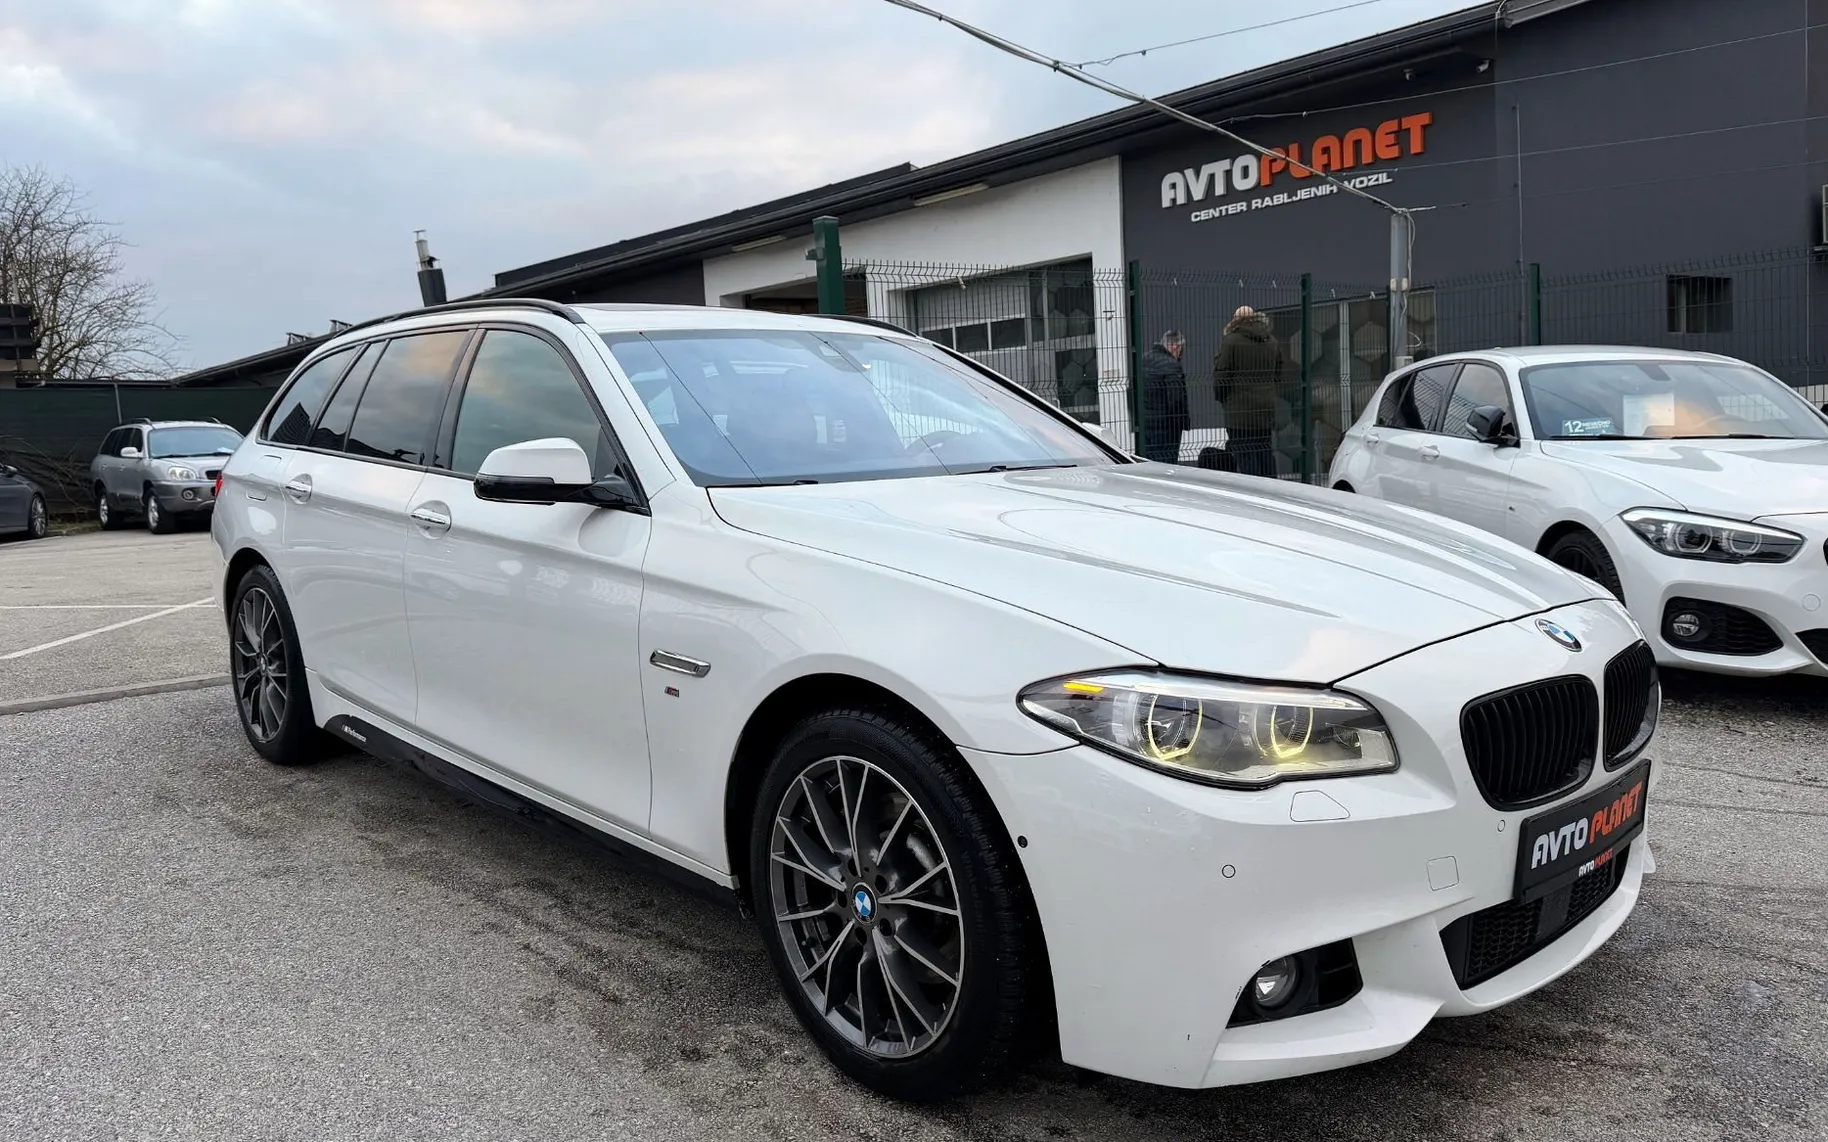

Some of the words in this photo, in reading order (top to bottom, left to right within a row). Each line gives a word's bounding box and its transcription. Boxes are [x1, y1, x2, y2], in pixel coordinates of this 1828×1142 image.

[1191, 202, 1247, 222] CENTER
[1251, 184, 1338, 210] RABLJENIH
[1344, 172, 1393, 190] VOZIL
[1564, 421, 1584, 433] 12
